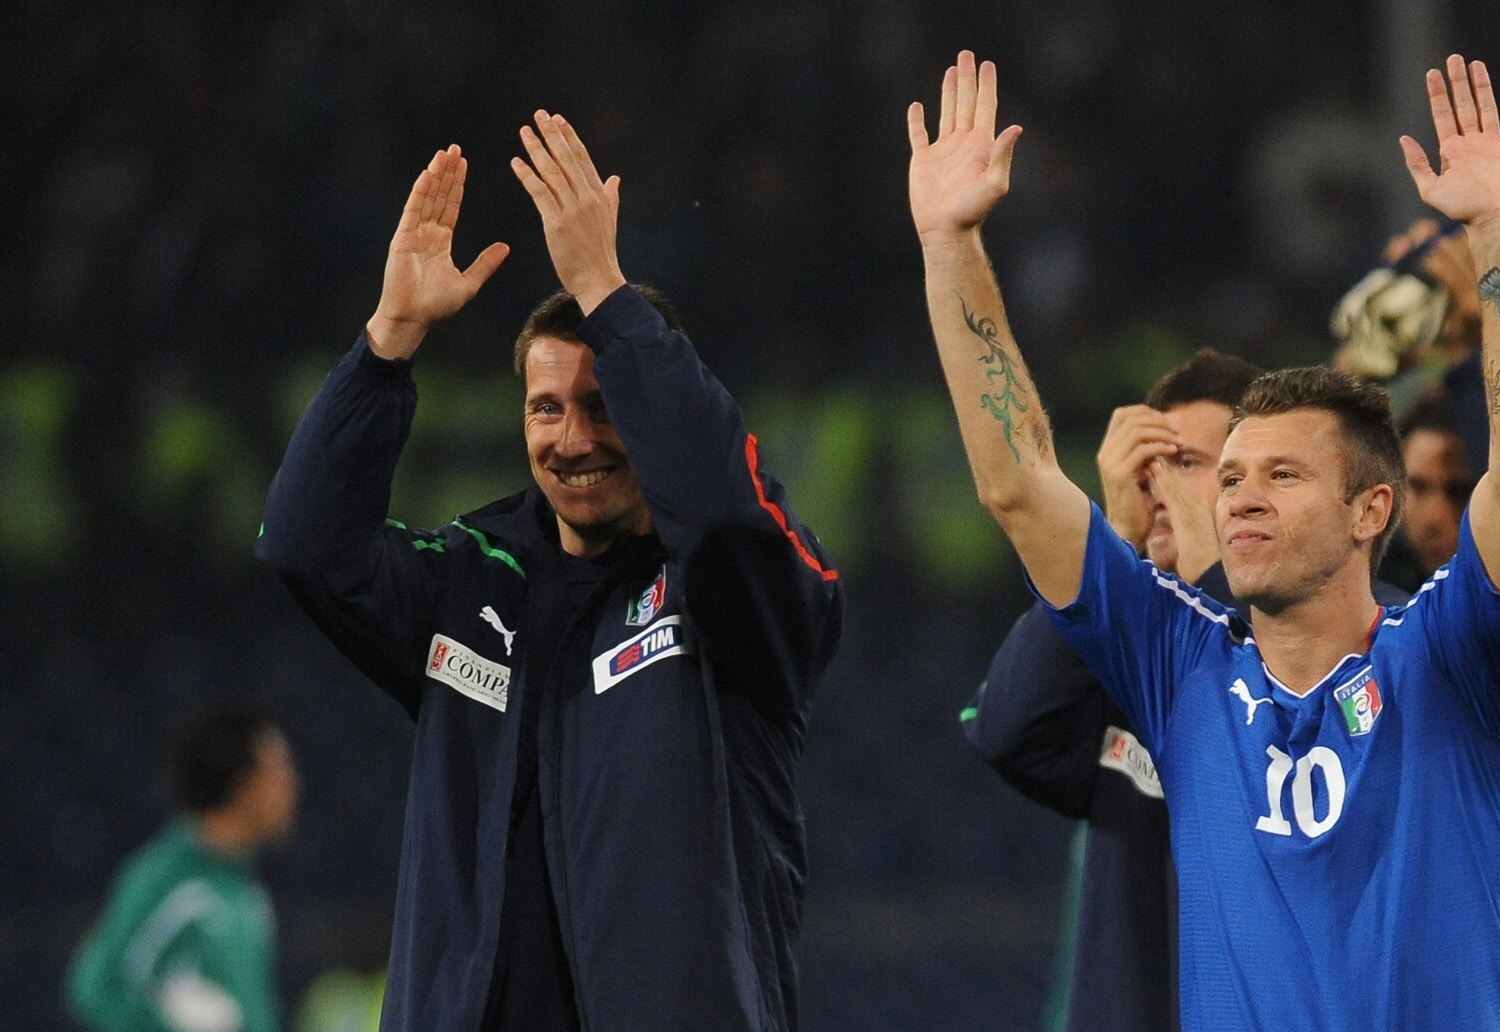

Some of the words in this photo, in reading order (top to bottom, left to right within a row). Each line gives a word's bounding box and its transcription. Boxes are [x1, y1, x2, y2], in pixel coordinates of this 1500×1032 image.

[640, 626, 675, 657] TIM
[1341, 674, 1372, 699] ITALIA
[1255, 744, 1347, 839] 10
